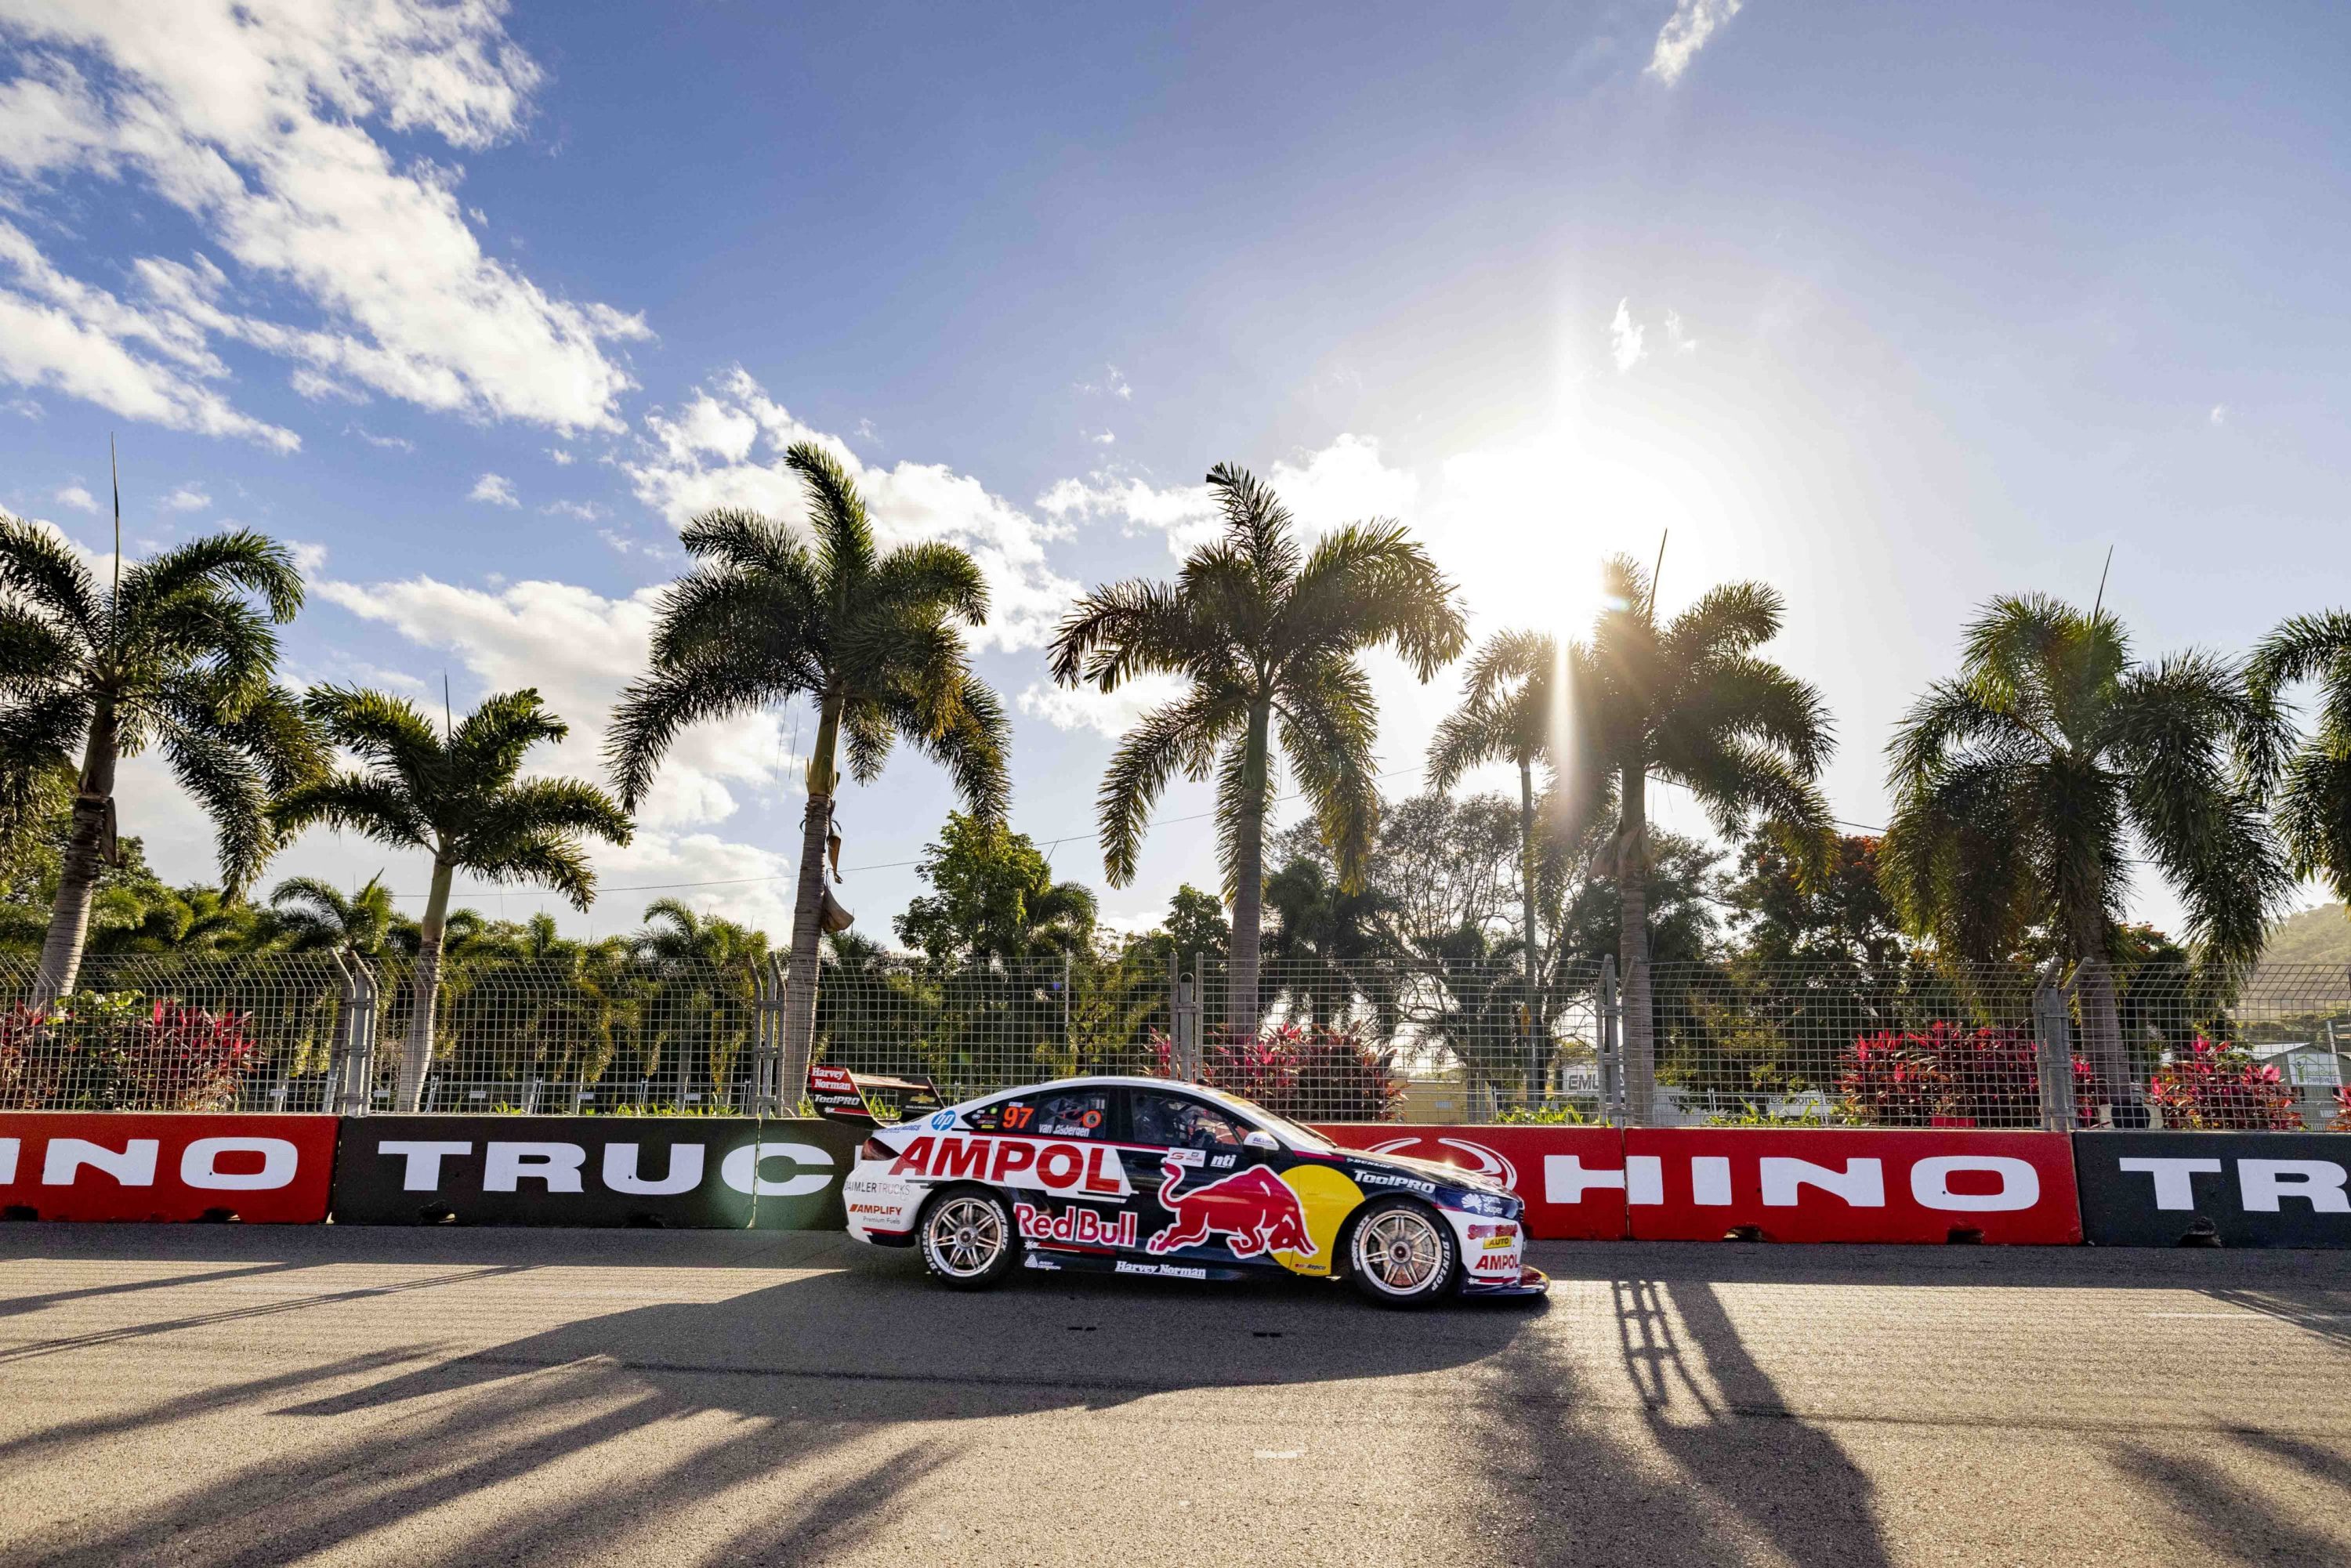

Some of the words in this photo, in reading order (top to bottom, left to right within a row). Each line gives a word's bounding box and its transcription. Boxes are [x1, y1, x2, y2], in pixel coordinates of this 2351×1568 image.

[812, 1067, 845, 1079] Harvey
[814, 1079, 851, 1090] Norman
[814, 1095, 860, 1106] ToolPRO
[936, 1111, 953, 1132] hp
[1002, 1106, 1034, 1129] 97
[1038, 1123, 1052, 1134] van
[378, 1141, 864, 1196] TRUC
[888, 1136, 1121, 1193] AMPOL
[1211, 1153, 1237, 1168] nti
[1352, 1159, 1394, 1169] DUNLOP
[1354, 1170, 1436, 1193] ToolPRO
[1544, 1154, 2040, 1212] HINO
[2119, 1157, 2351, 1213] TR
[857, 1204, 903, 1216] AMPLIFY
[1483, 1203, 1503, 1215] Super
[922, 1222, 938, 1270] DUNLOP
[1116, 1261, 1158, 1275] Harvey
[1159, 1264, 1207, 1278] Norman
[1431, 1240, 1451, 1291] DUNLOP
[1474, 1254, 1519, 1270] AMPOL
